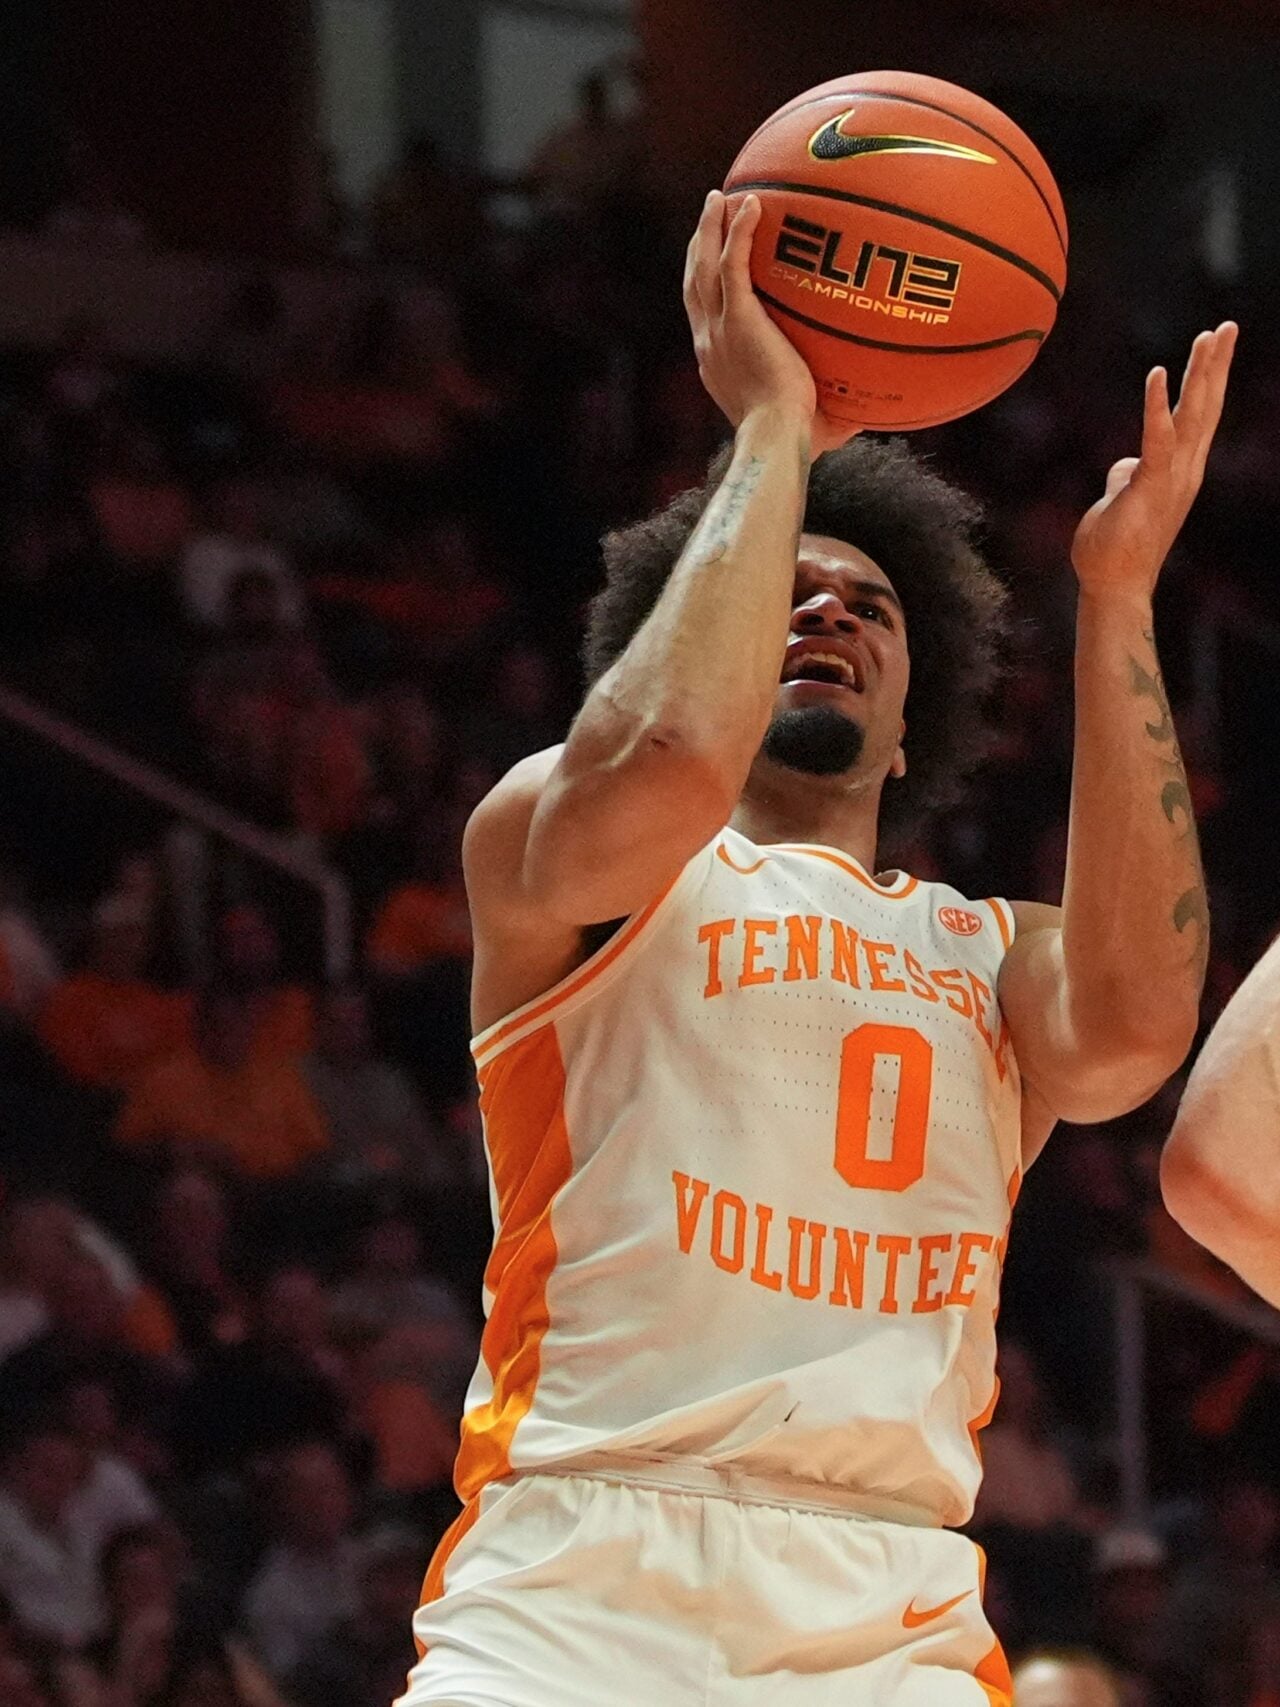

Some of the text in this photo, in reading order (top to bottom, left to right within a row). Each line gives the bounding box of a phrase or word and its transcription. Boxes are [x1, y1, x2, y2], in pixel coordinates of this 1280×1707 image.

[770, 265, 951, 325] CHAMPIONSHIP
[773, 213, 963, 312] ELITE
[939, 907, 981, 934] SEC
[833, 1022, 933, 1193] 0
[671, 1169, 1009, 1315] VOLUNTEE
